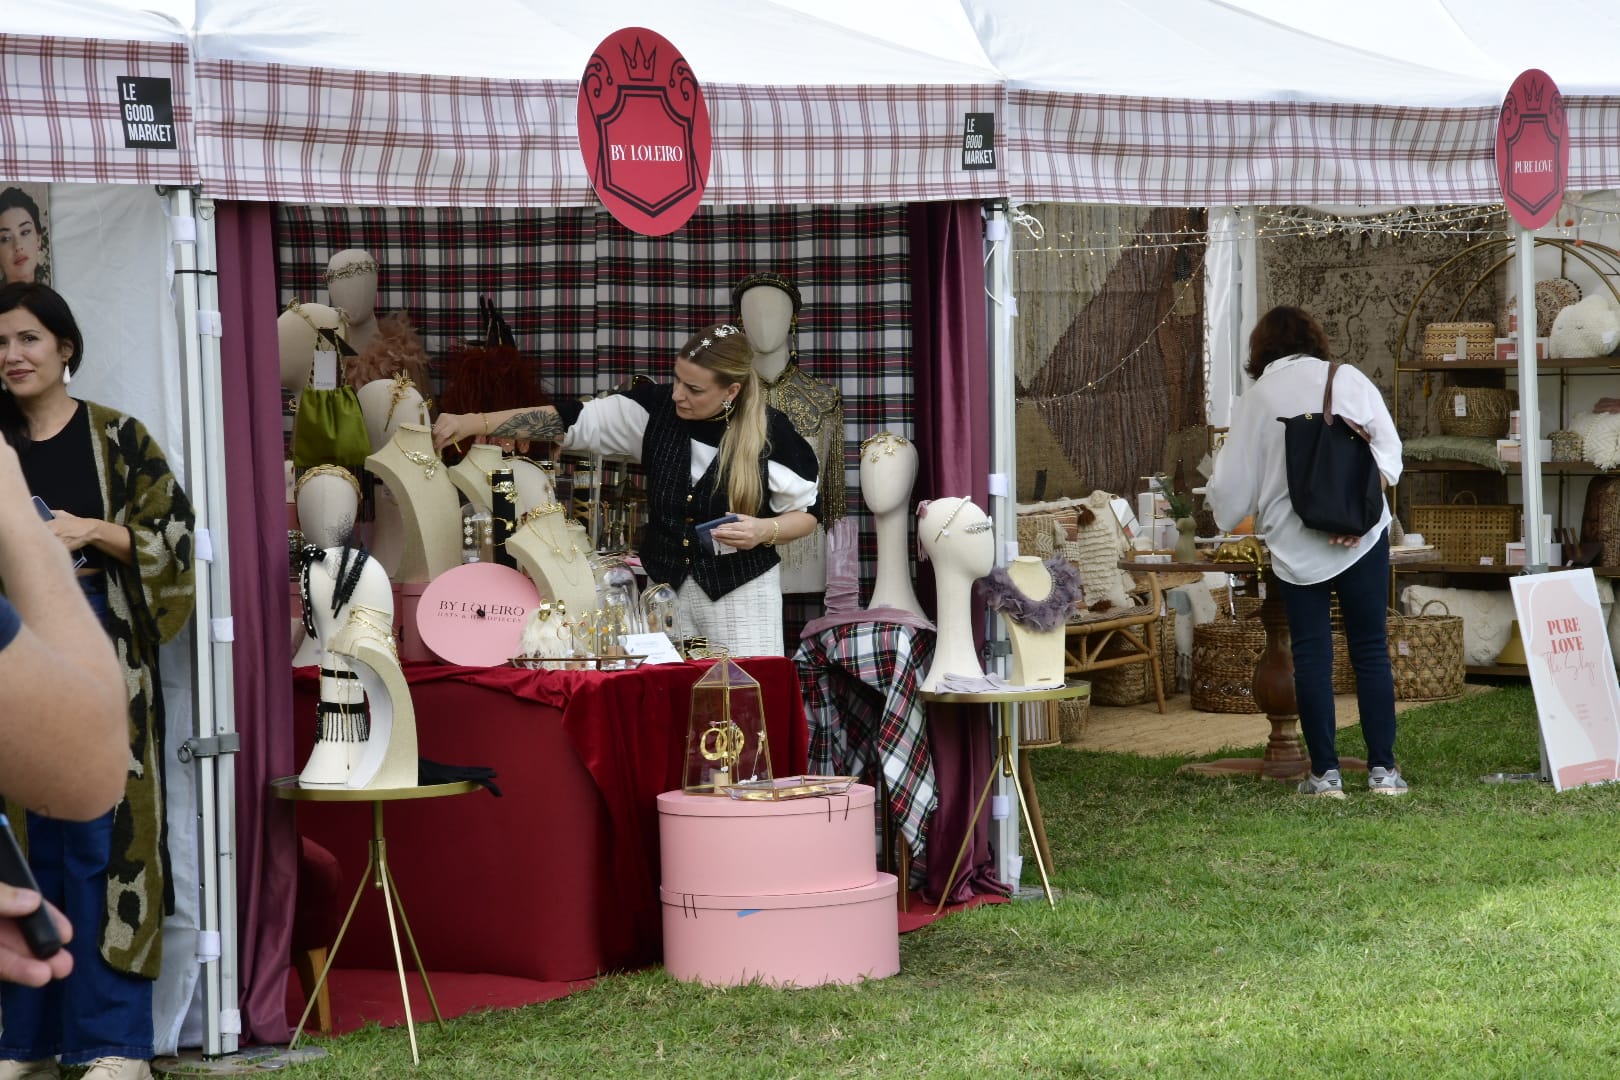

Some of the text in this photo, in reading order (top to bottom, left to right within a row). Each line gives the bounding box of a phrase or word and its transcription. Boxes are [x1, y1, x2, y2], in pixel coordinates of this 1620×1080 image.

[122, 83, 137, 101] LE
[124, 103, 155, 122] GOOD
[127, 123, 171, 142] MARKET
[966, 118, 976, 133] LE
[965, 134, 983, 149] GOOD
[610, 144, 683, 162] BY LOLEIRO
[964, 149, 993, 165] MARKET
[1514, 159, 1553, 174] PURE LOVE
[439, 600, 525, 617] BY LOLEIRO
[1546, 616, 1581, 636] PURE
[1551, 636, 1585, 655] LOVE
